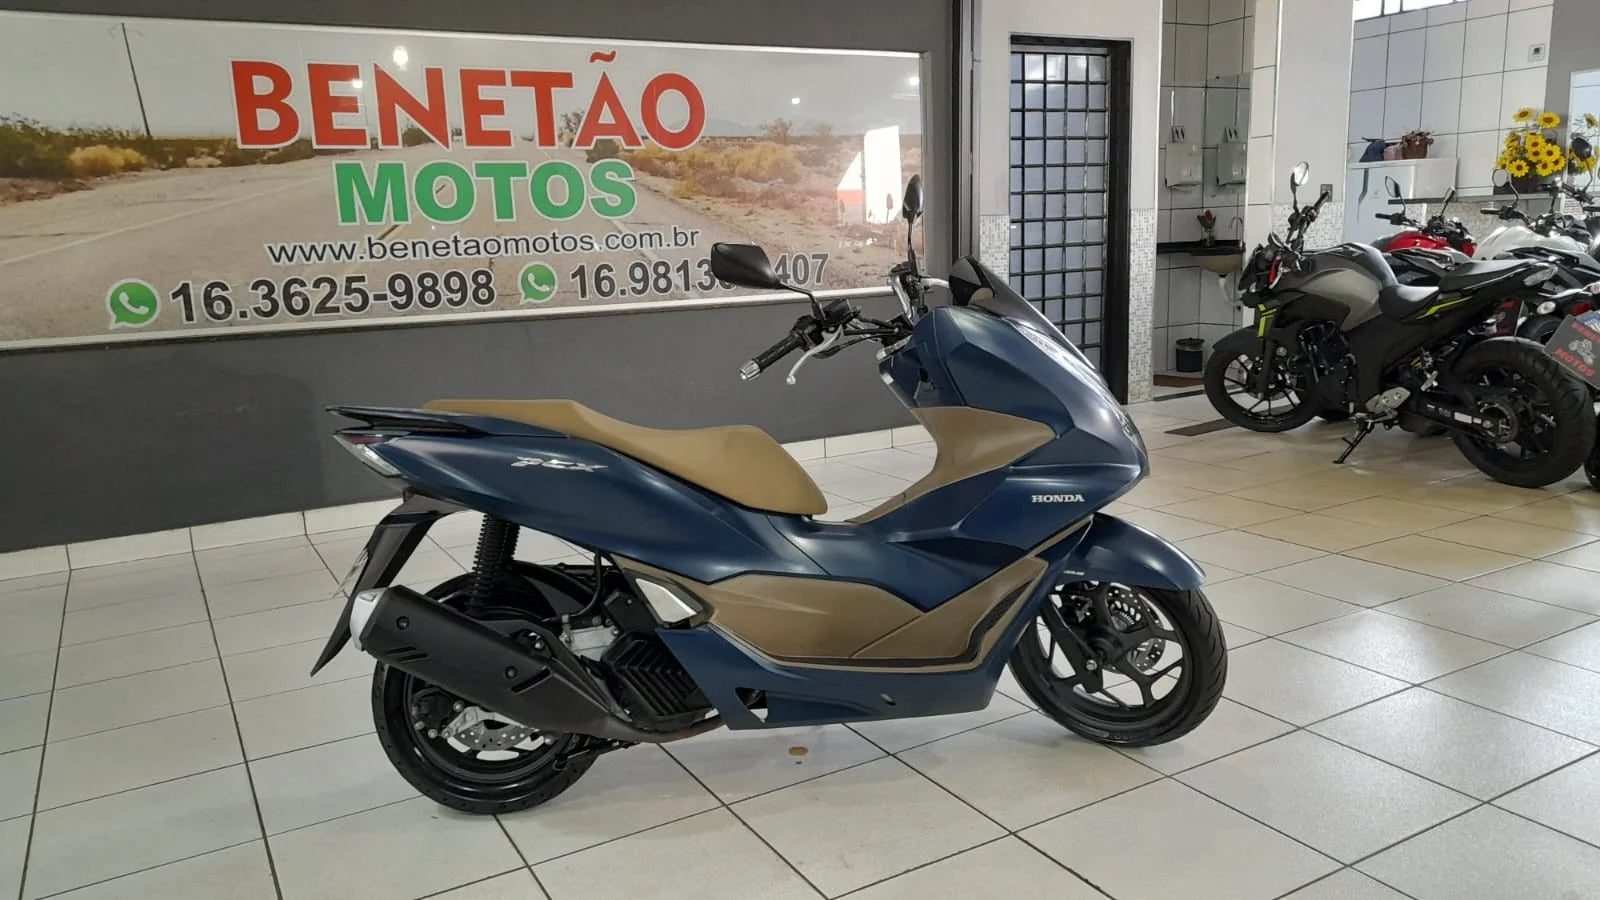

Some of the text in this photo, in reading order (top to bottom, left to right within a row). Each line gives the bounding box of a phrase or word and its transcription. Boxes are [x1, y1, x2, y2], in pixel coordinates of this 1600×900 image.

[231, 50, 706, 150] BENETÃO
[335, 160, 637, 227] MOTOS
[267, 226, 700, 264] www.benetaomotos.com.br
[171, 269, 495, 322] 16.3625-9898
[1031, 494, 1086, 503] HONDA
